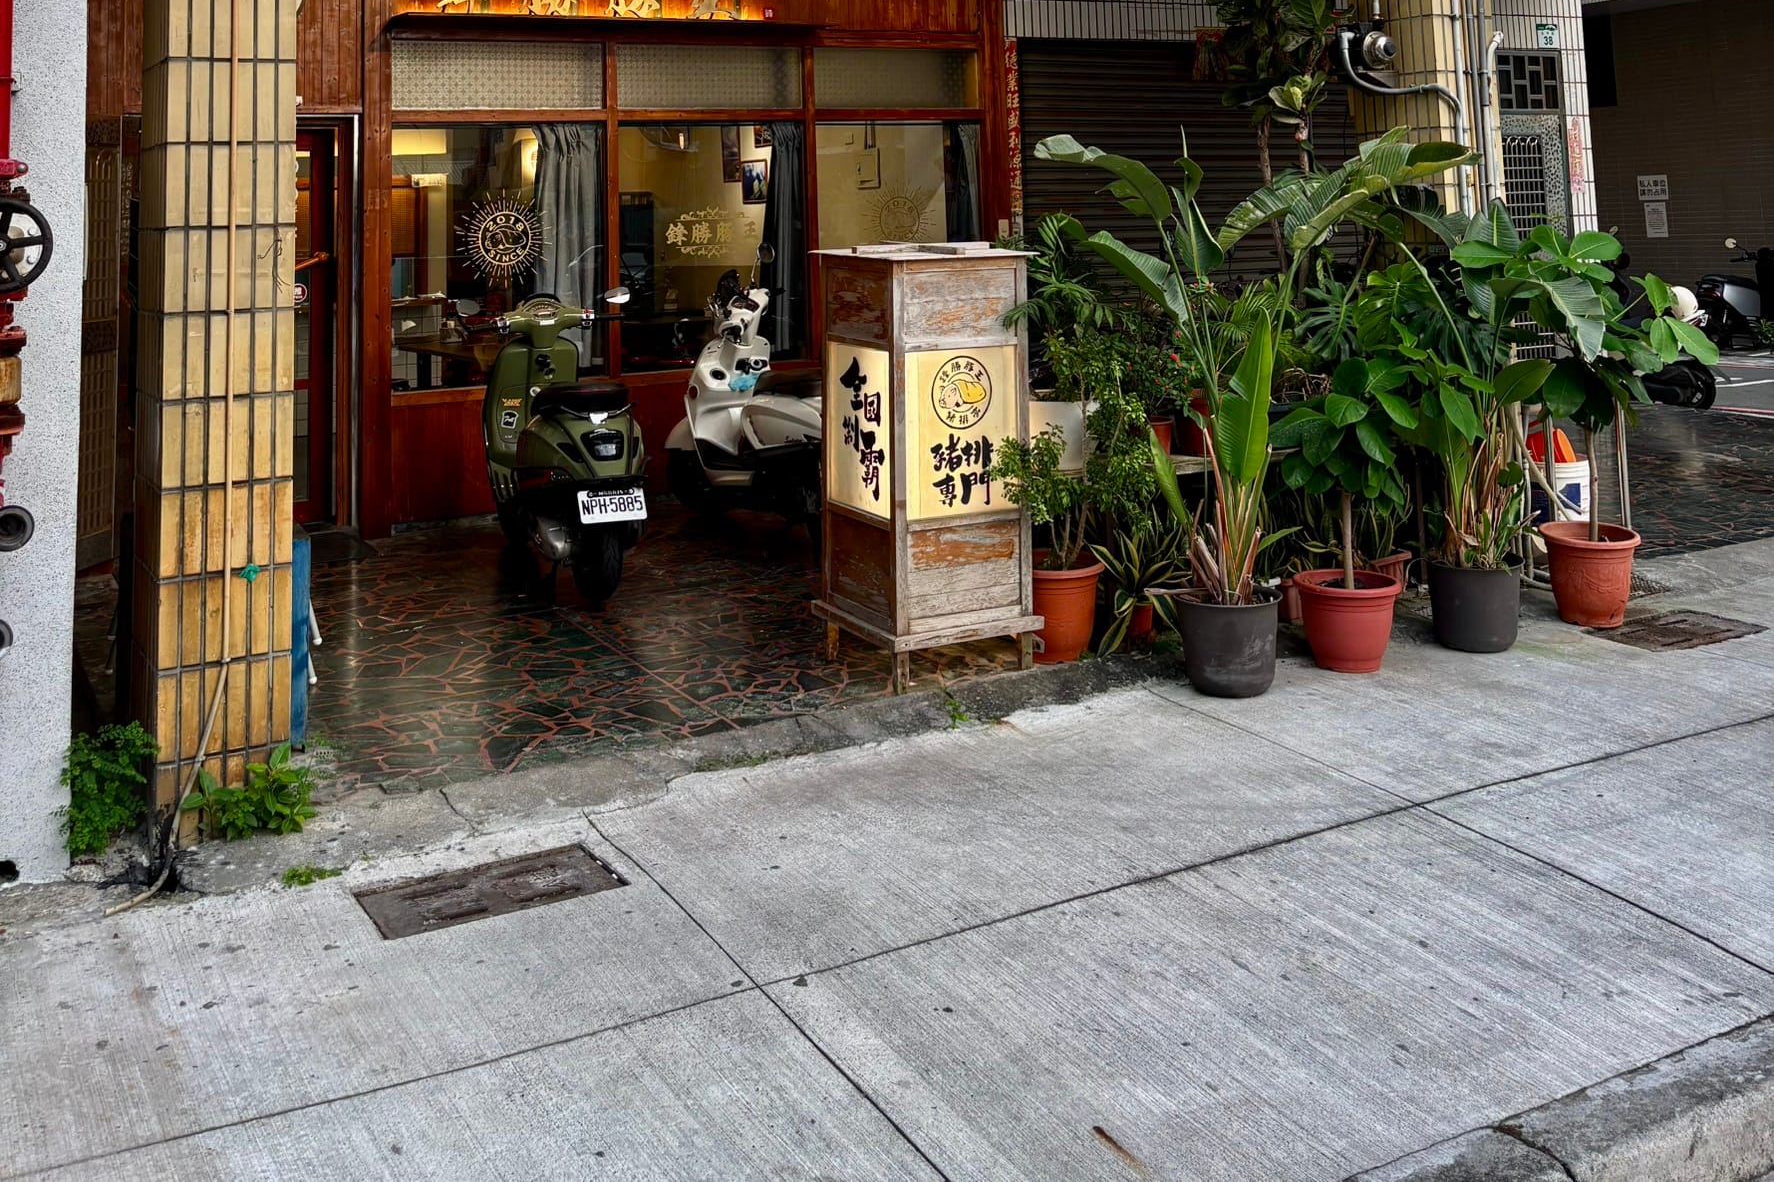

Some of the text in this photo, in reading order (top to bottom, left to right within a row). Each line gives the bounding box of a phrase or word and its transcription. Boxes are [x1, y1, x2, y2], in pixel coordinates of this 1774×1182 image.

[1543, 36, 1554, 46] 38
[486, 216, 525, 232] 2018
[665, 220, 760, 246] 鋒勝豚王
[487, 246, 525, 263] SINCE
[930, 433, 995, 472] 豬排
[932, 472, 991, 508] 專門
[581, 496, 643, 516] NPH-5885
